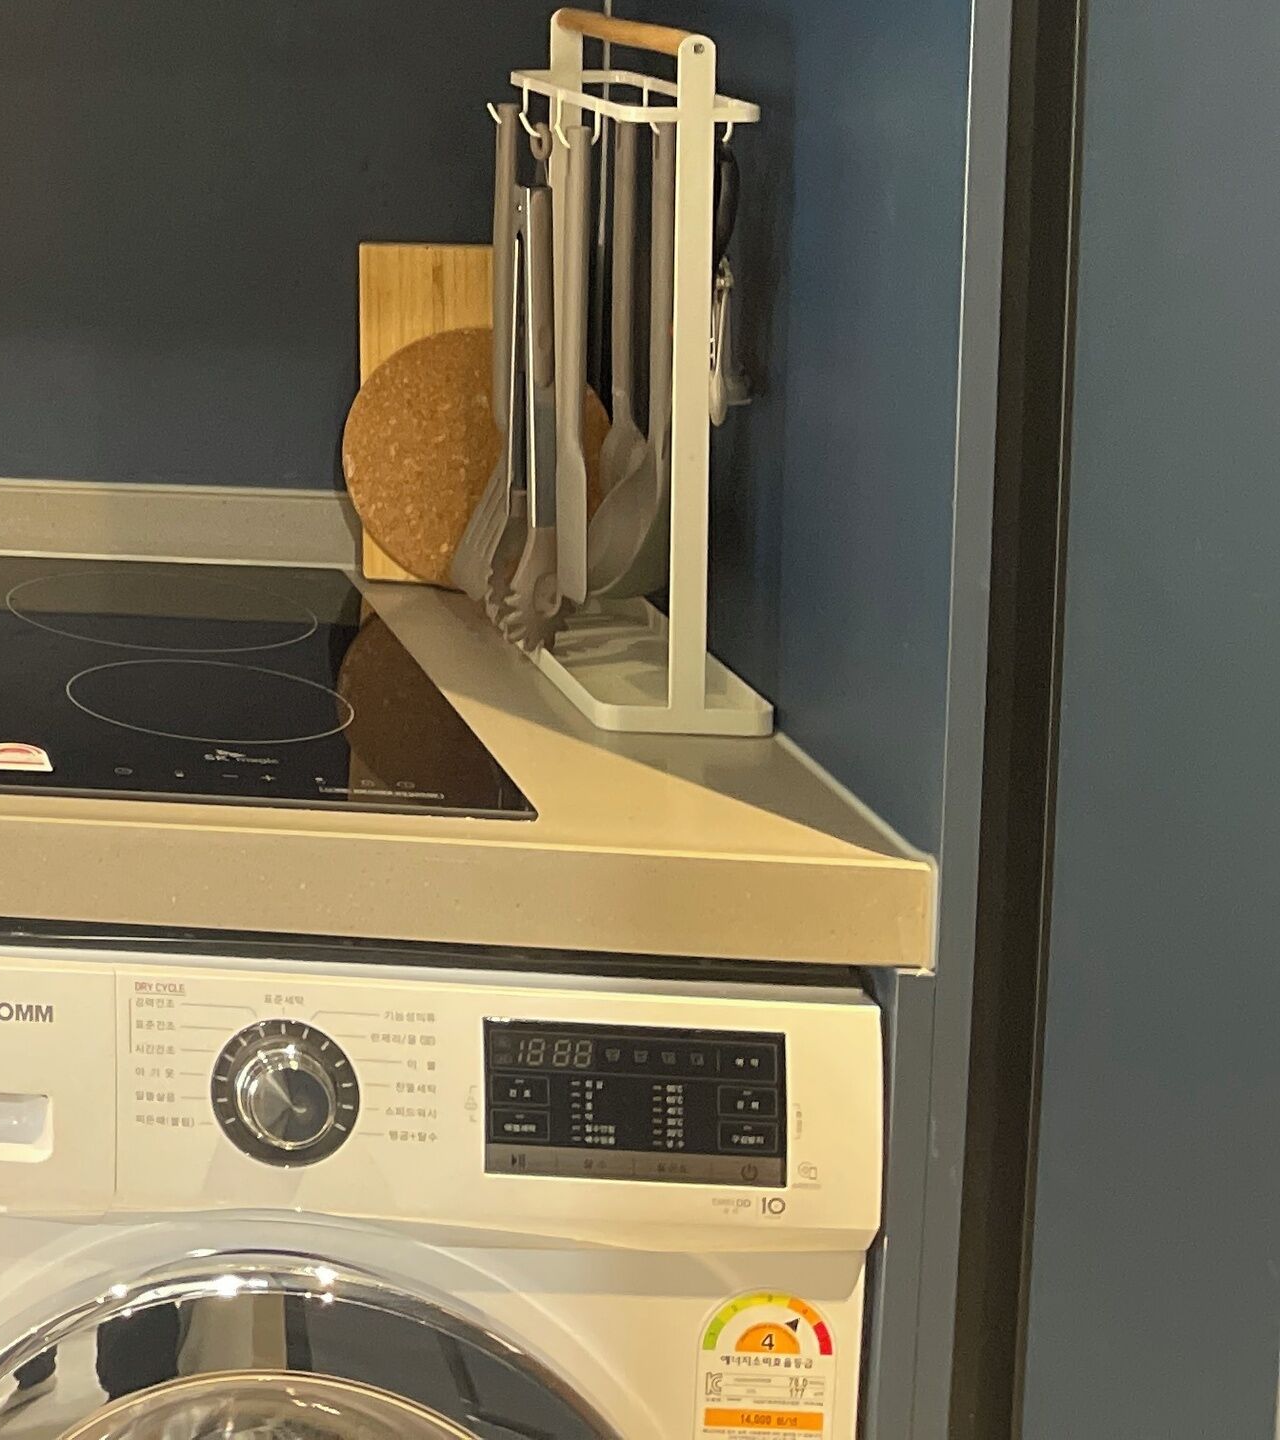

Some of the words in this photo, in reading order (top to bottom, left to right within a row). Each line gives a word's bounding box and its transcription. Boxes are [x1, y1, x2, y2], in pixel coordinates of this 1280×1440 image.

[134, 981, 153, 992] DRY
[155, 983, 185, 993] CYCLE
[761, 1333, 775, 1350] 4
[720, 1355, 813, 1369] 에너지소비효율등급
